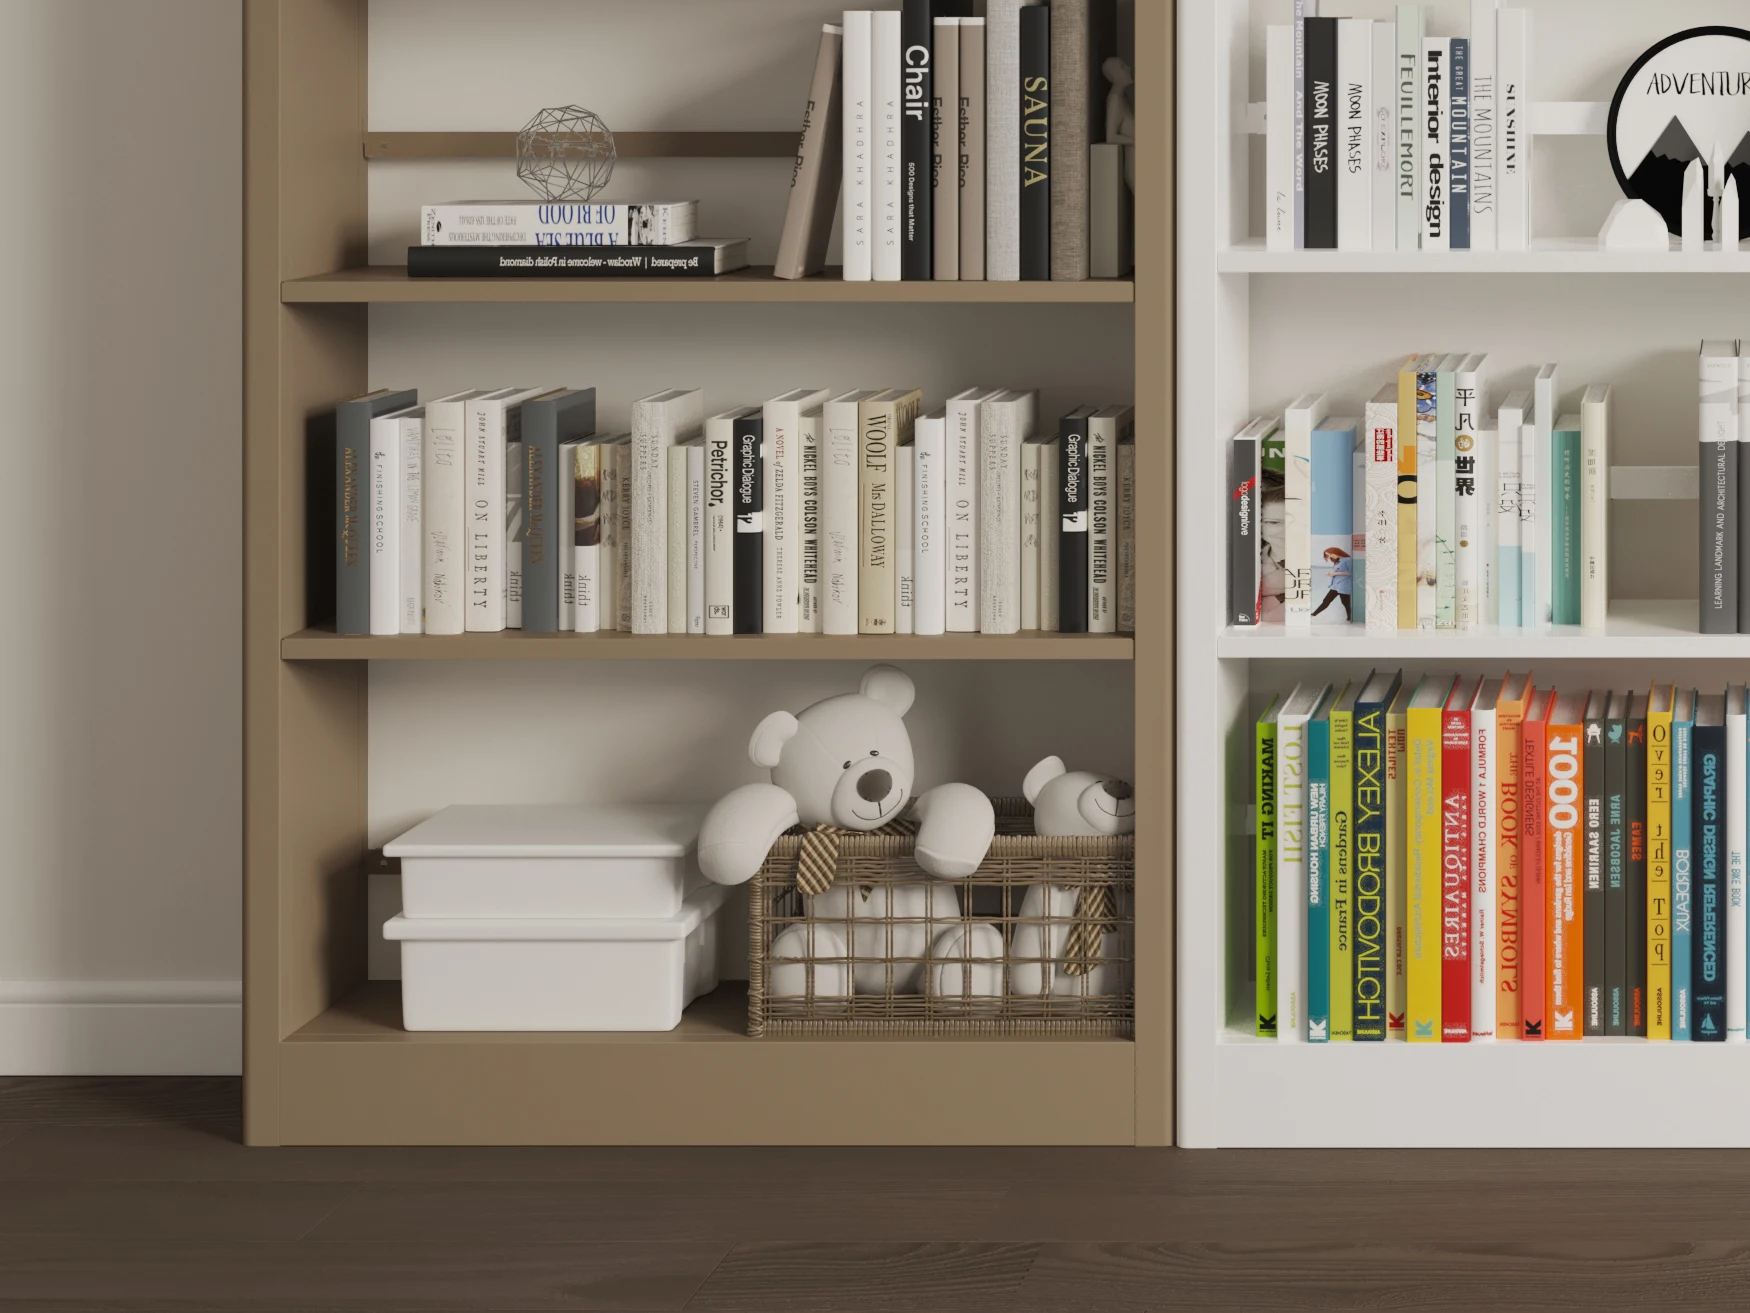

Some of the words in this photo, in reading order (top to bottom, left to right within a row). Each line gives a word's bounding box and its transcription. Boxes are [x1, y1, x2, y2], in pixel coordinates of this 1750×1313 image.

[905, 45, 929, 121] Chair
[1024, 77, 1048, 188] SAUNA
[907, 177, 915, 203] Designs
[865, 414, 887, 472] WOOLF
[1066, 434, 1080, 466] Graphic
[1093, 445, 1106, 472] NICKEL
[870, 483, 884, 500] Mrs
[1066, 467, 1080, 503] Dialogue
[1093, 476, 1106, 496] BOYS
[1715, 453, 1726, 510] ARCHITECTURAL
[955, 500, 968, 521] ON
[1093, 499, 1106, 534] COLSON
[1715, 513, 1725, 529] AND
[870, 502, 884, 568] DALLOWAY
[1714, 531, 1724, 570] LANDMARK
[955, 534, 968, 609] LIBERTY
[1093, 539, 1106, 584] WHITEHEAD
[1714, 573, 1723, 609] LEARNING
